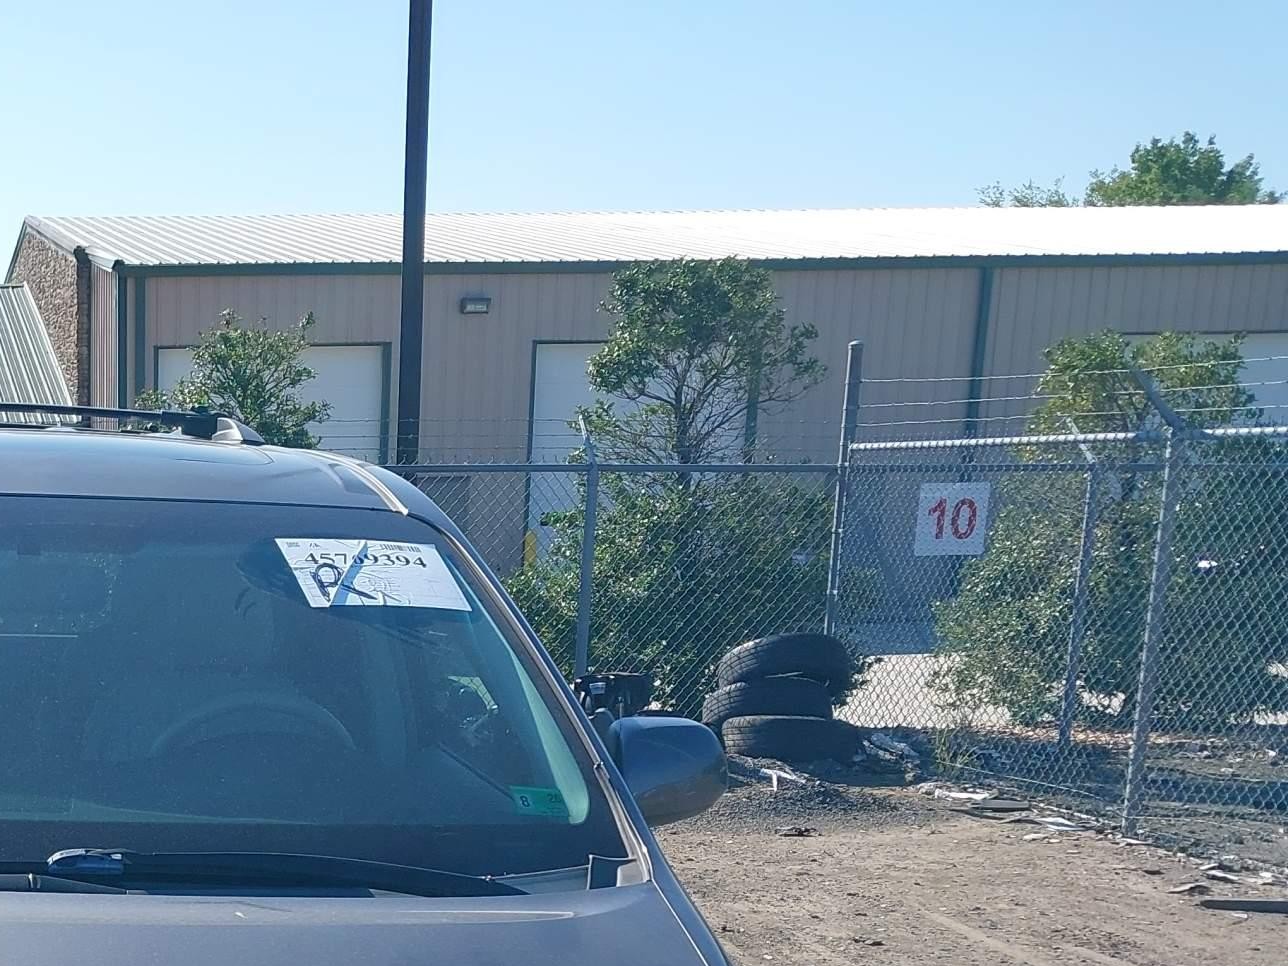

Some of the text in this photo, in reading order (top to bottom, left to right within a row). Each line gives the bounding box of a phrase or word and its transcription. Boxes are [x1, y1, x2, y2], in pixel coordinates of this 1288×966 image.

[927, 497, 977, 540] 10
[304, 552, 427, 568] 45769394
[519, 795, 530, 808] 8
